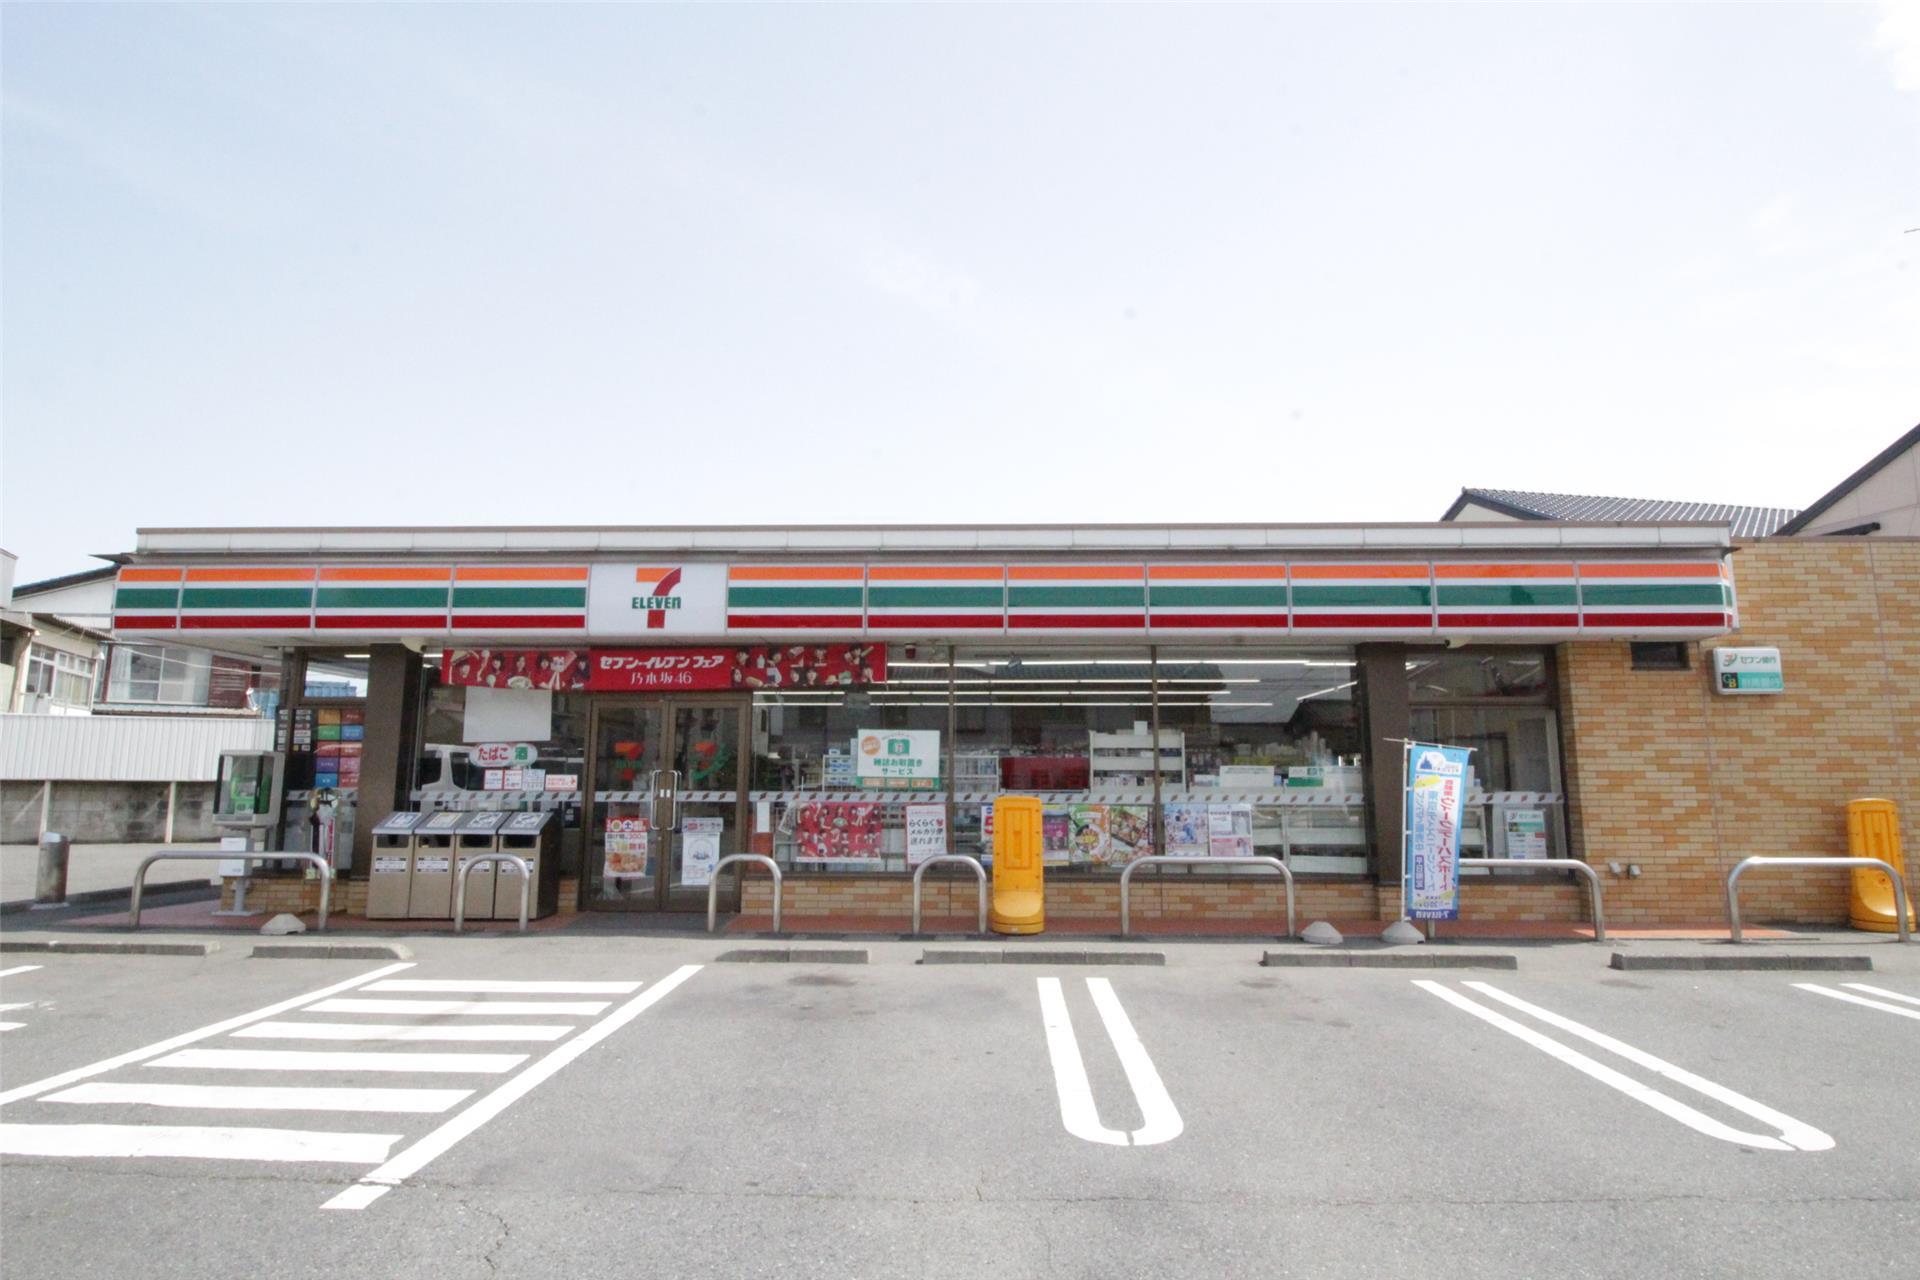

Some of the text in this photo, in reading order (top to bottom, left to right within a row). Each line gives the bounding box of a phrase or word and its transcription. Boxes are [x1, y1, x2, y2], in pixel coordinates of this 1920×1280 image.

[636, 566, 681, 628] 7
[693, 655, 725, 669] フェア
[631, 671, 693, 685] 乃木坂46
[478, 747, 509, 761] たばこ
[515, 746, 528, 760] 酒
[882, 768, 914, 776] サービス
[909, 819, 935, 827] らくらく
